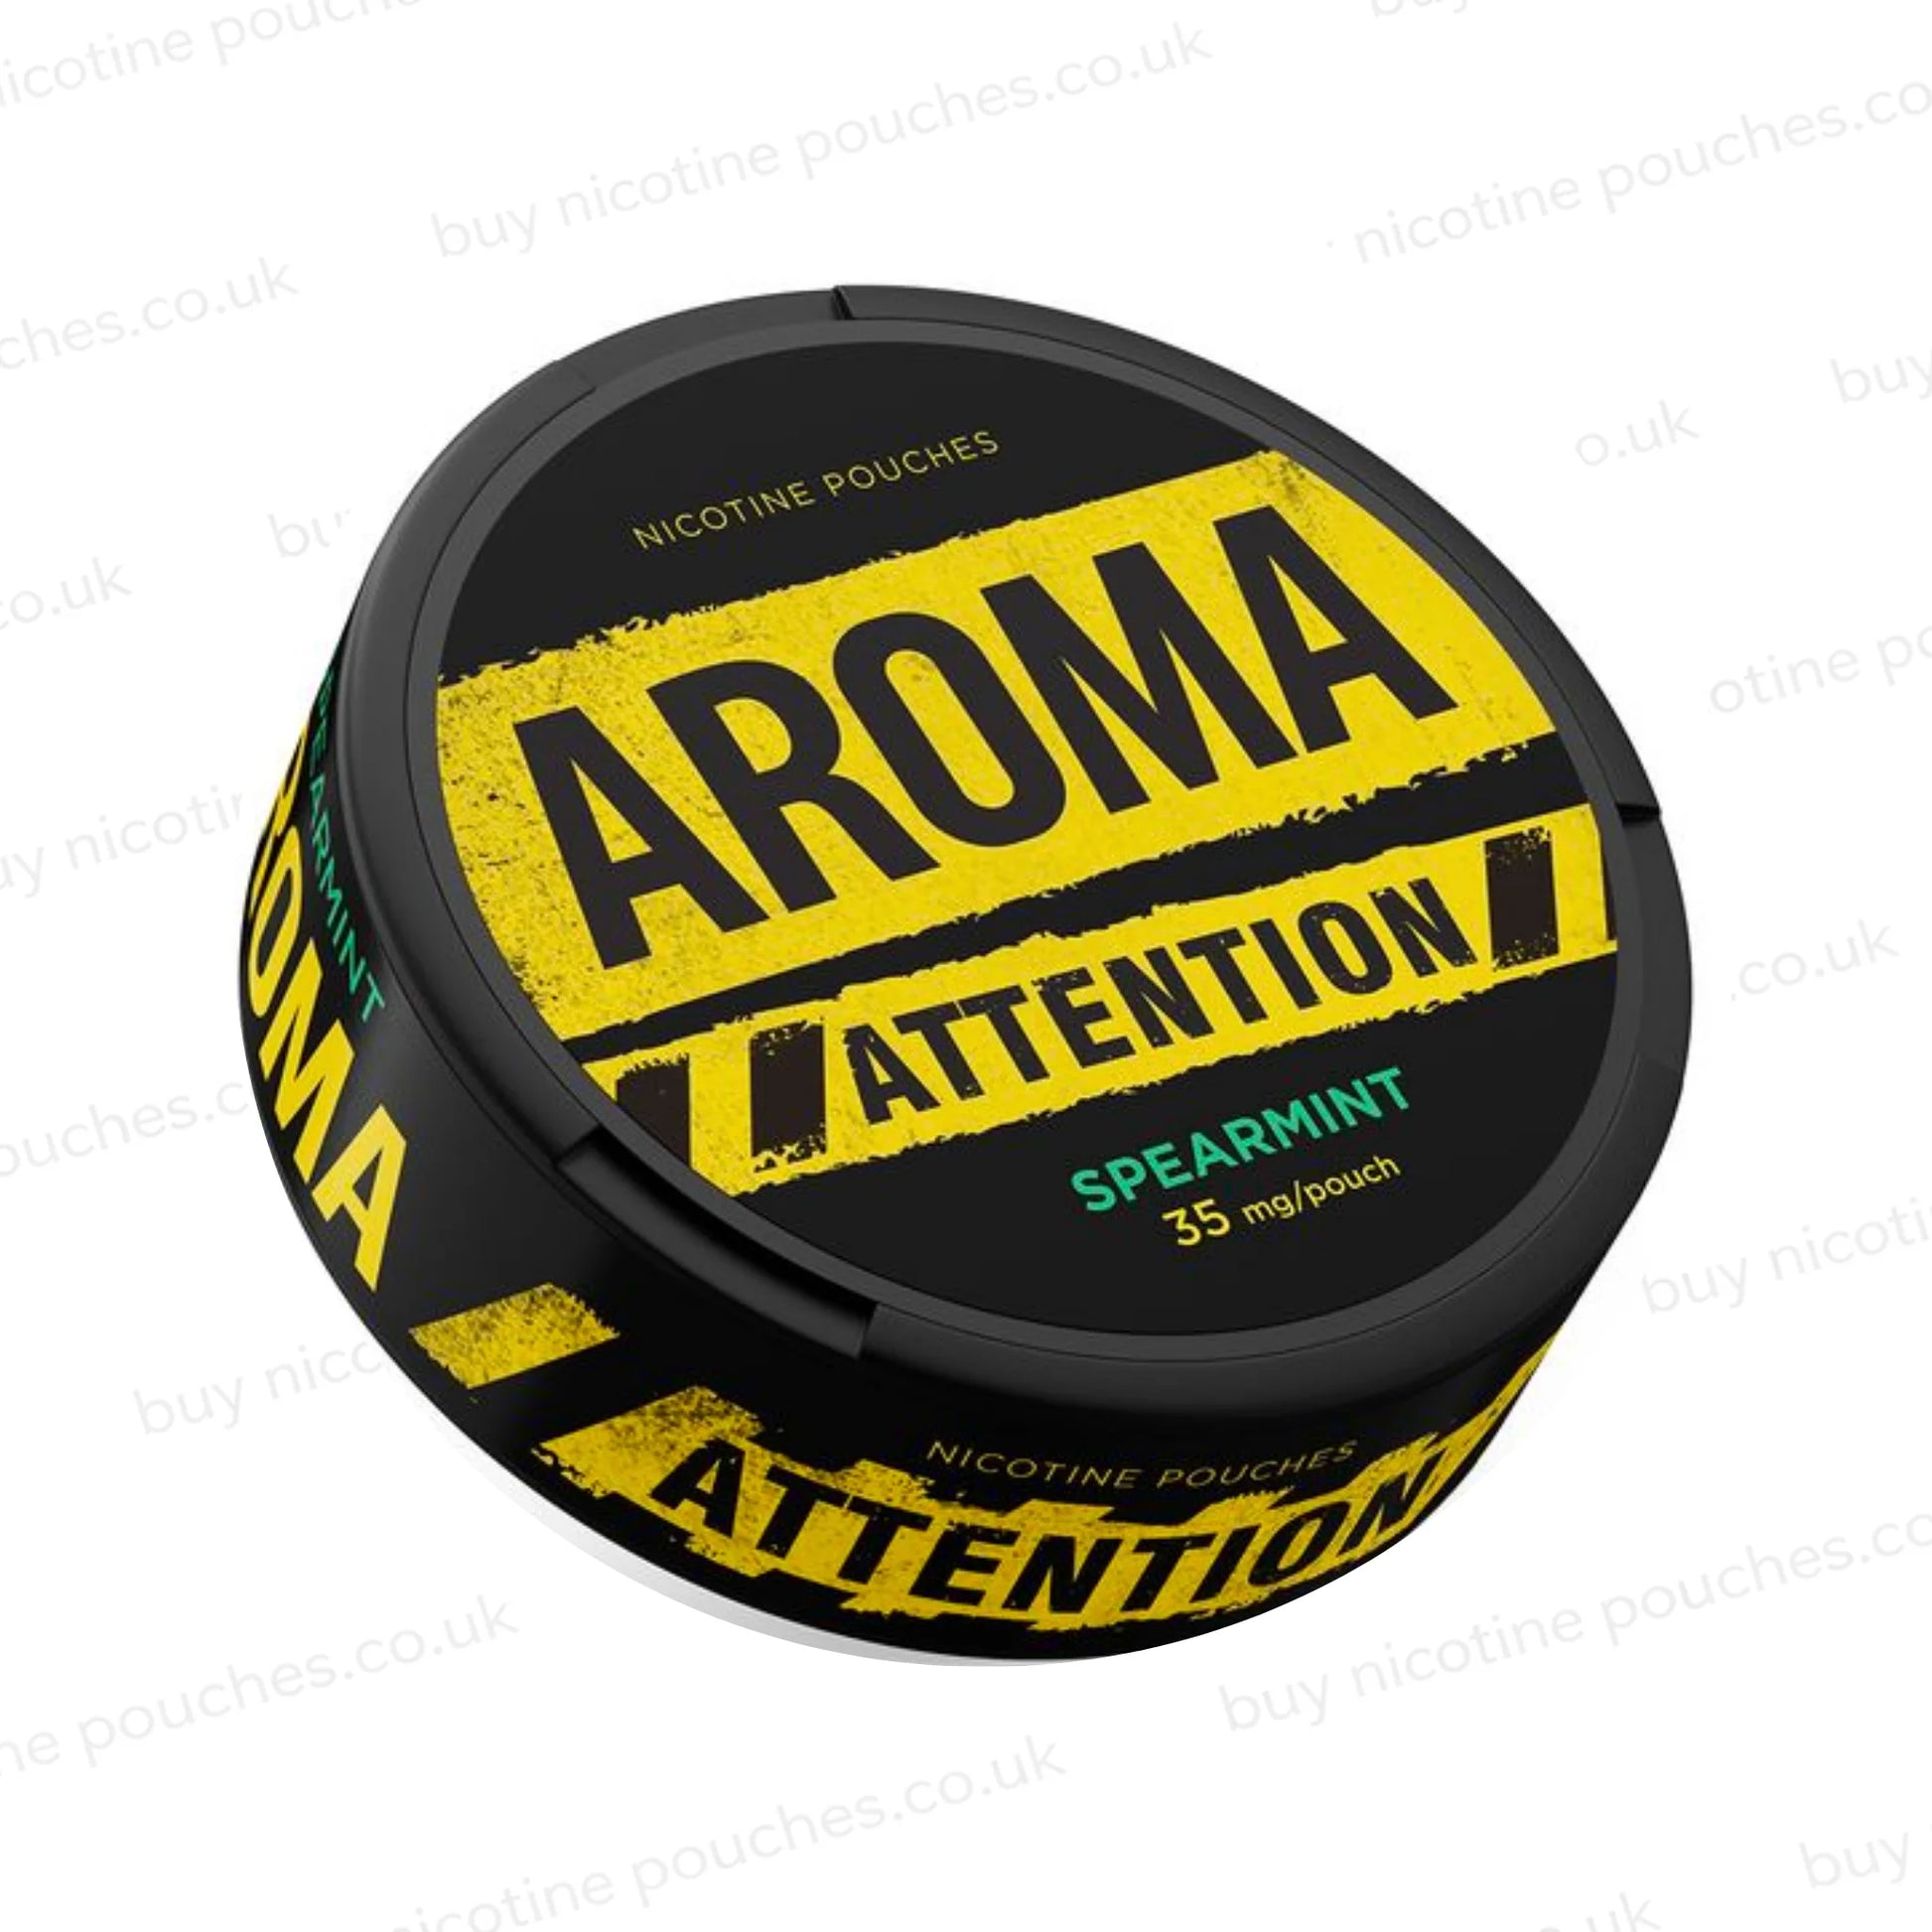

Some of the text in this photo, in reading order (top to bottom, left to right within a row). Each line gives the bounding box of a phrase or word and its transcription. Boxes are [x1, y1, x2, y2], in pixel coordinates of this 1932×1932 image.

[633, 430, 1000, 550] NICOTINE POUCHES
[512, 504, 1457, 970] AROMA
[246, 725, 408, 1292] ROMA
[846, 878, 1476, 1125] ATTENTION
[1070, 1066, 1410, 1212] SPEARMINT
[1164, 1154, 1401, 1247] 35 mg/pouch
[650, 1440, 1450, 1613] ATTENTION
[926, 1439, 1357, 1490] NICOTINE POUCHES
